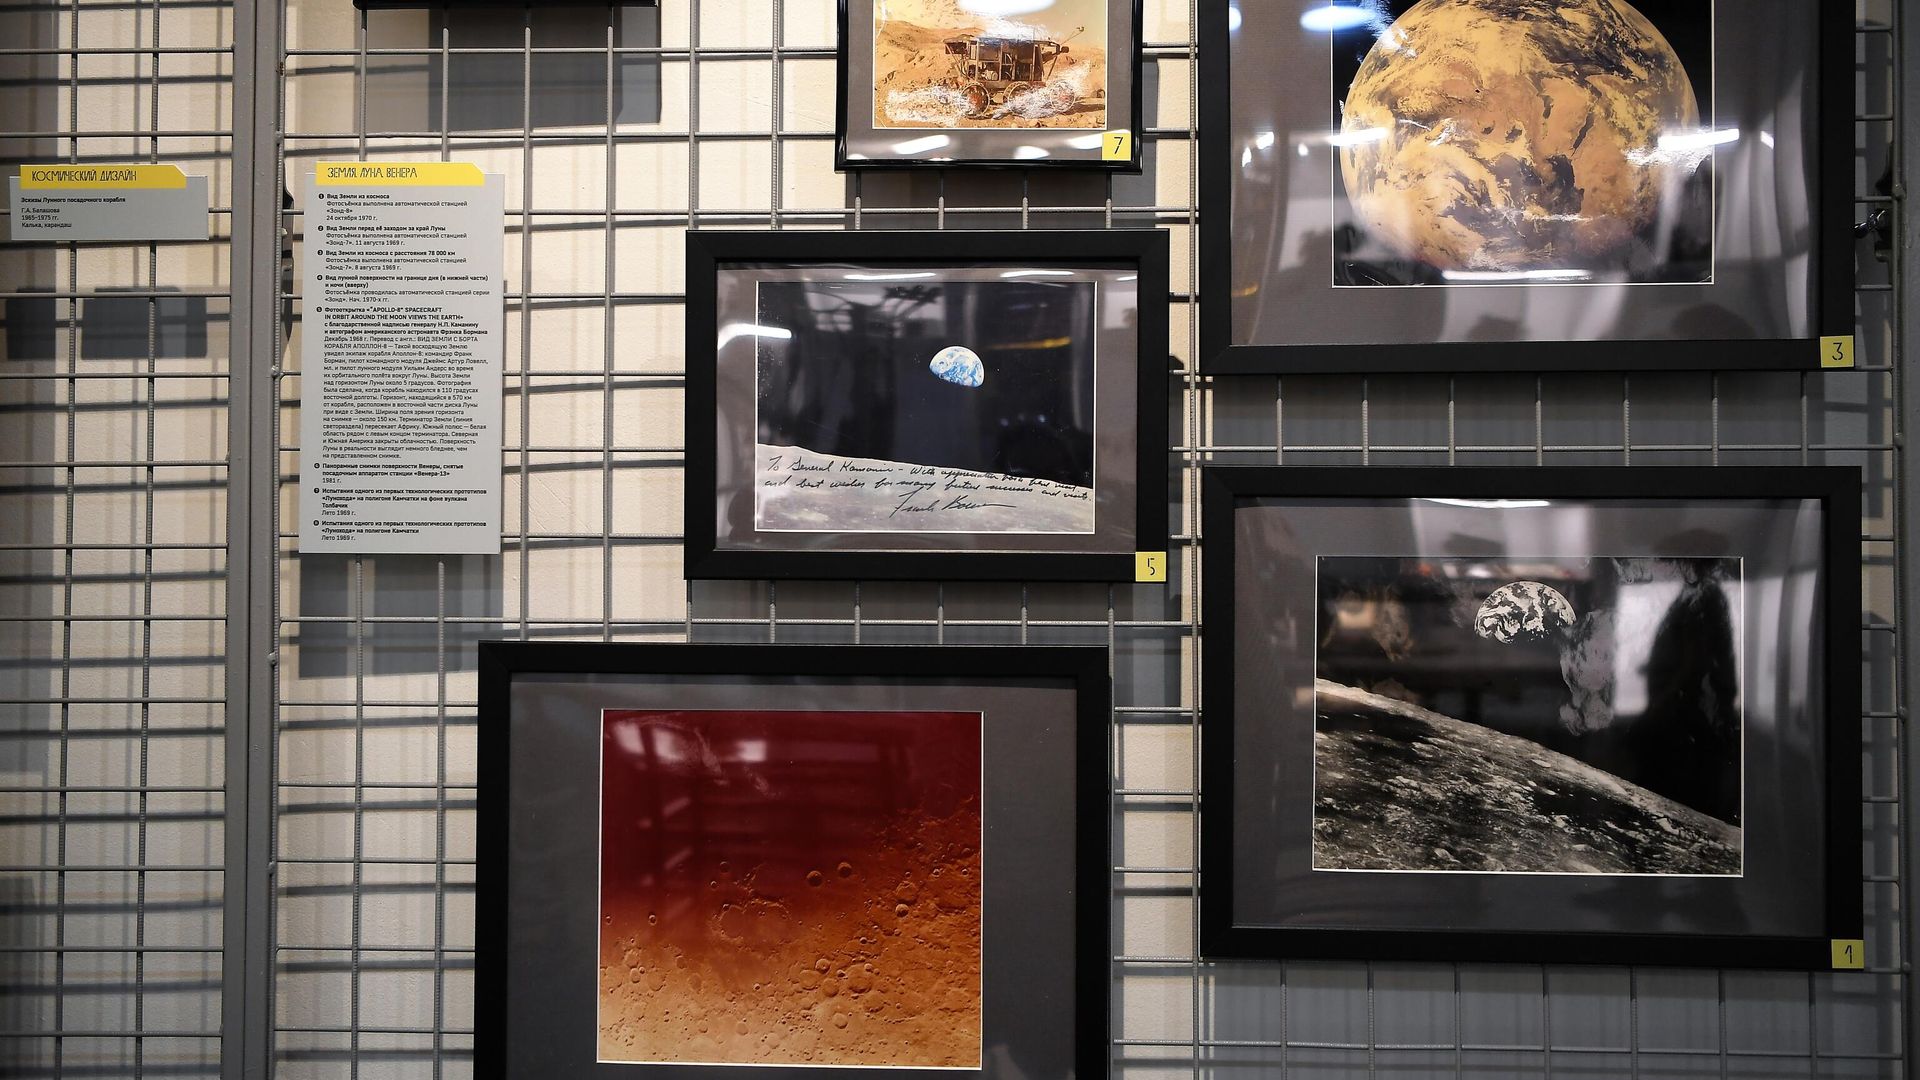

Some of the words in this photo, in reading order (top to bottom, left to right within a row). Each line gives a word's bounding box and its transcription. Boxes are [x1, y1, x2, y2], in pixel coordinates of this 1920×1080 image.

[1113, 136, 1124, 155] 7
[32, 170, 97, 181] КОСМИЧЕСКИЙ
[99, 170, 136, 181] ДИЗАЙН
[327, 167, 357, 178] ЗЕМЛЯ
[360, 167, 384, 178] ЛУНА
[386, 167, 418, 178] ВЕНЕРА
[1832, 342, 1844, 361] 3
[767, 456, 783, 471] To
[787, 457, 834, 472] General
[764, 475, 792, 486] and
[796, 478, 824, 489] best
[1146, 558, 1155, 576] 5
[1845, 945, 1853, 964] 1
